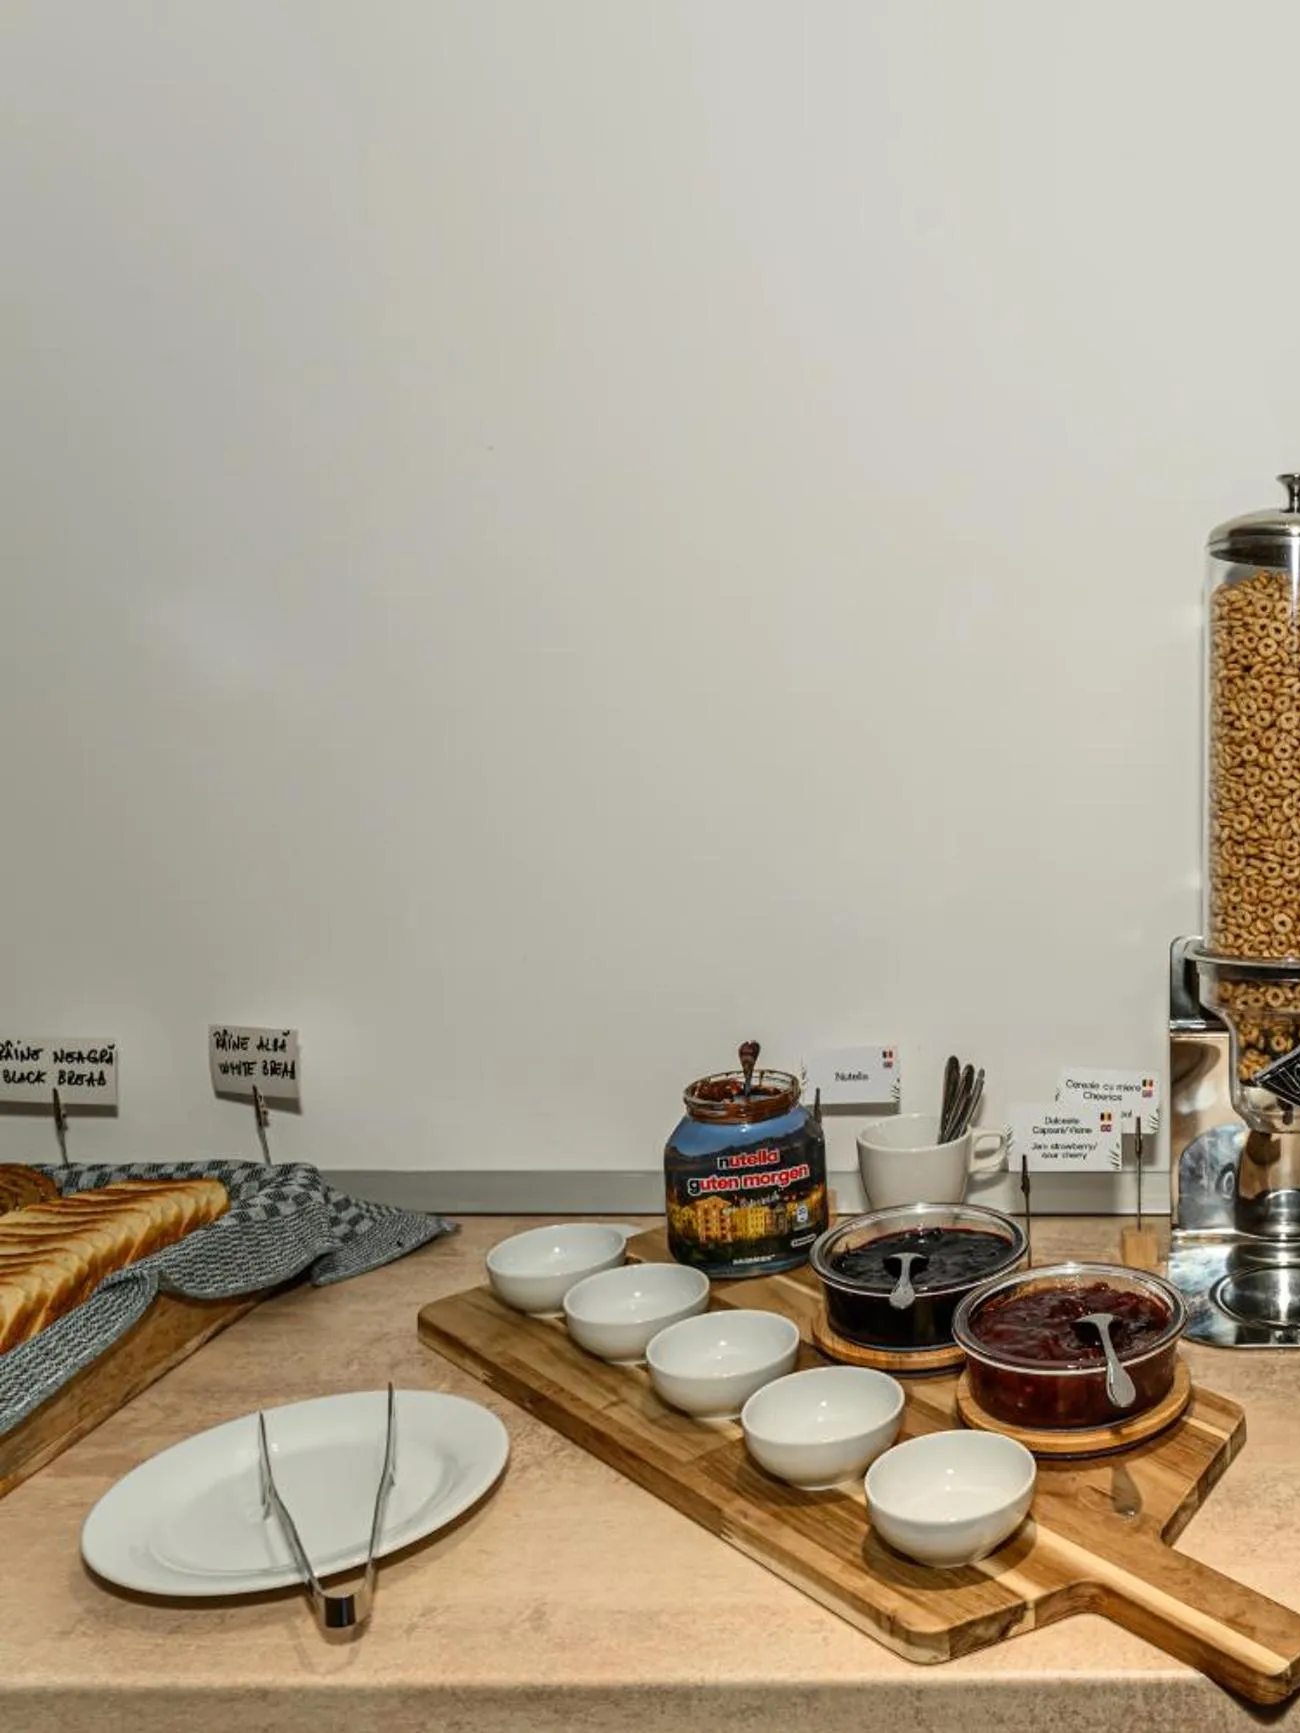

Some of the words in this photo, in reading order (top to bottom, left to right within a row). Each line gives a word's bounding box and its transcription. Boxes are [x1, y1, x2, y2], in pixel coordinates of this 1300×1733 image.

[218, 1060, 257, 1076] WHITE
[3, 1069, 46, 1084] BLACK
[835, 1072, 869, 1081] Nutella
[717, 1149, 781, 1170] nutella
[687, 1175, 740, 1196] guten
[741, 1164, 810, 1189] morgen
